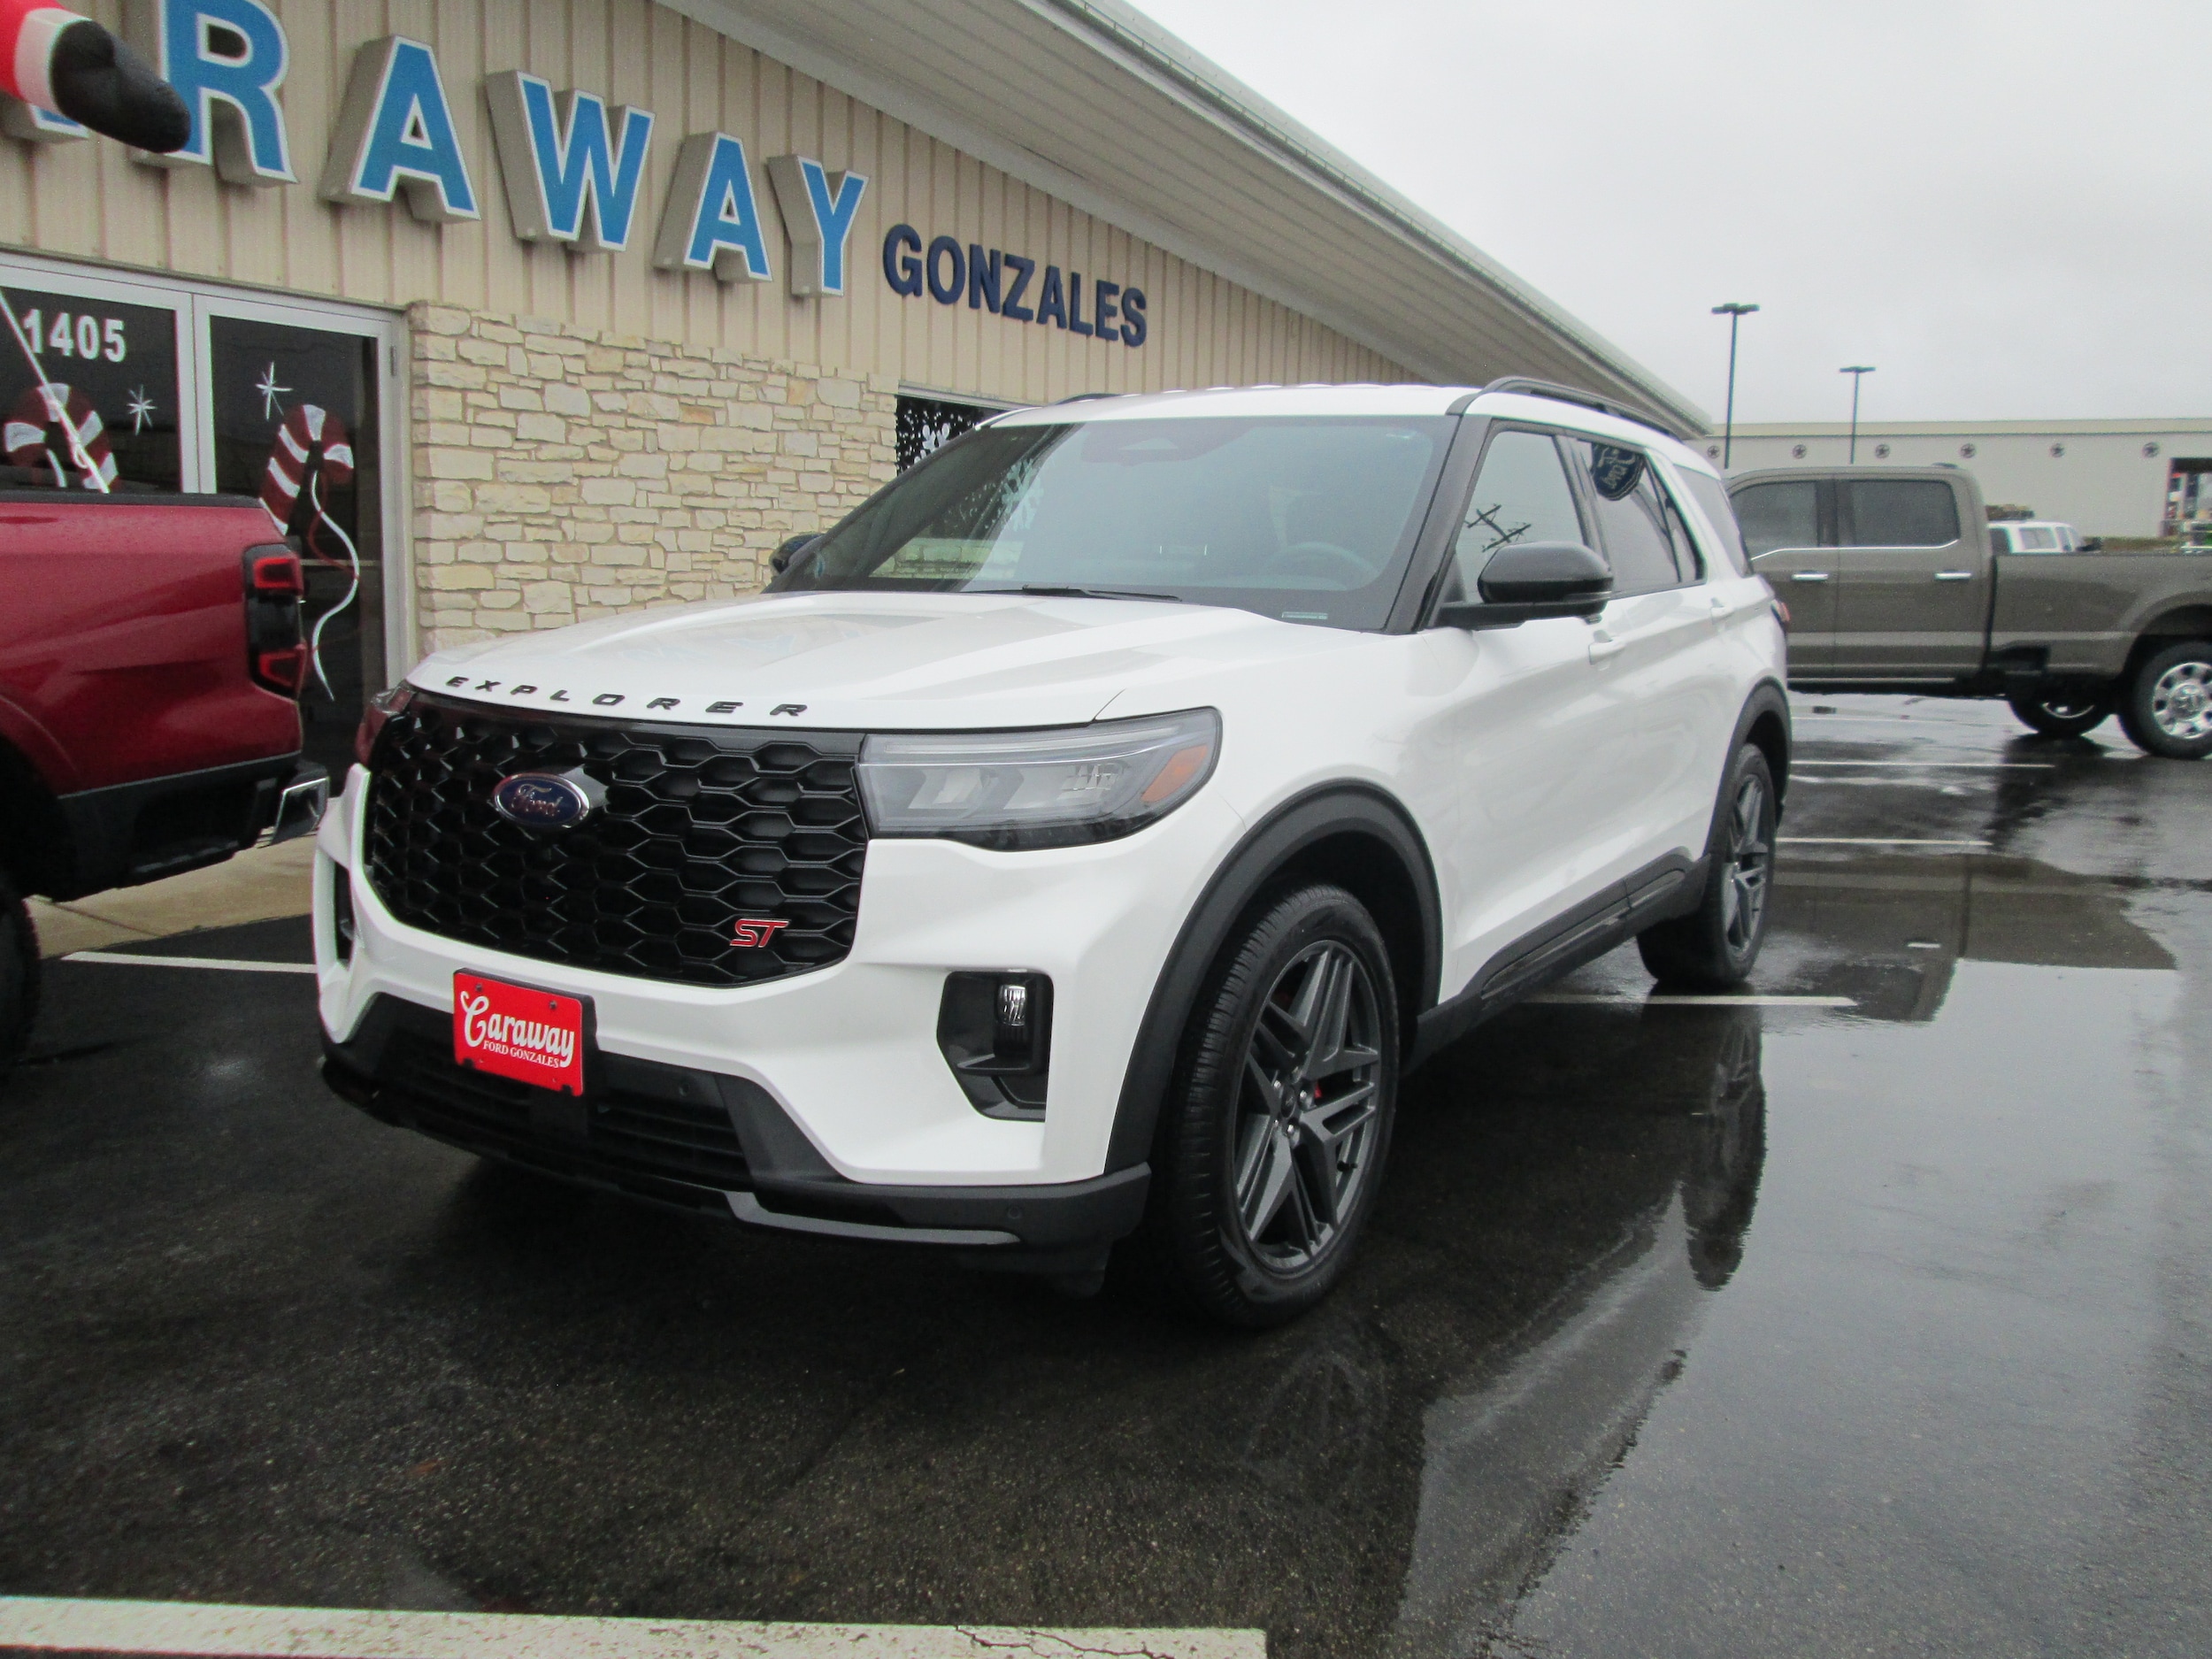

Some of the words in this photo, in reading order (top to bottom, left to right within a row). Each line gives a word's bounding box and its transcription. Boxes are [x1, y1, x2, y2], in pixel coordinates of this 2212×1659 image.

[29, 0, 869, 296] RAWAY
[884, 224, 1148, 347] GONZALES
[23, 308, 127, 363] 1405
[445, 676, 808, 717] EXPLORER
[511, 783, 564, 817] Ford
[729, 918, 790, 949] ST
[460, 990, 575, 1067] Caraway
[483, 1041, 509, 1055] FORD
[511, 1048, 559, 1067] GONZALES
